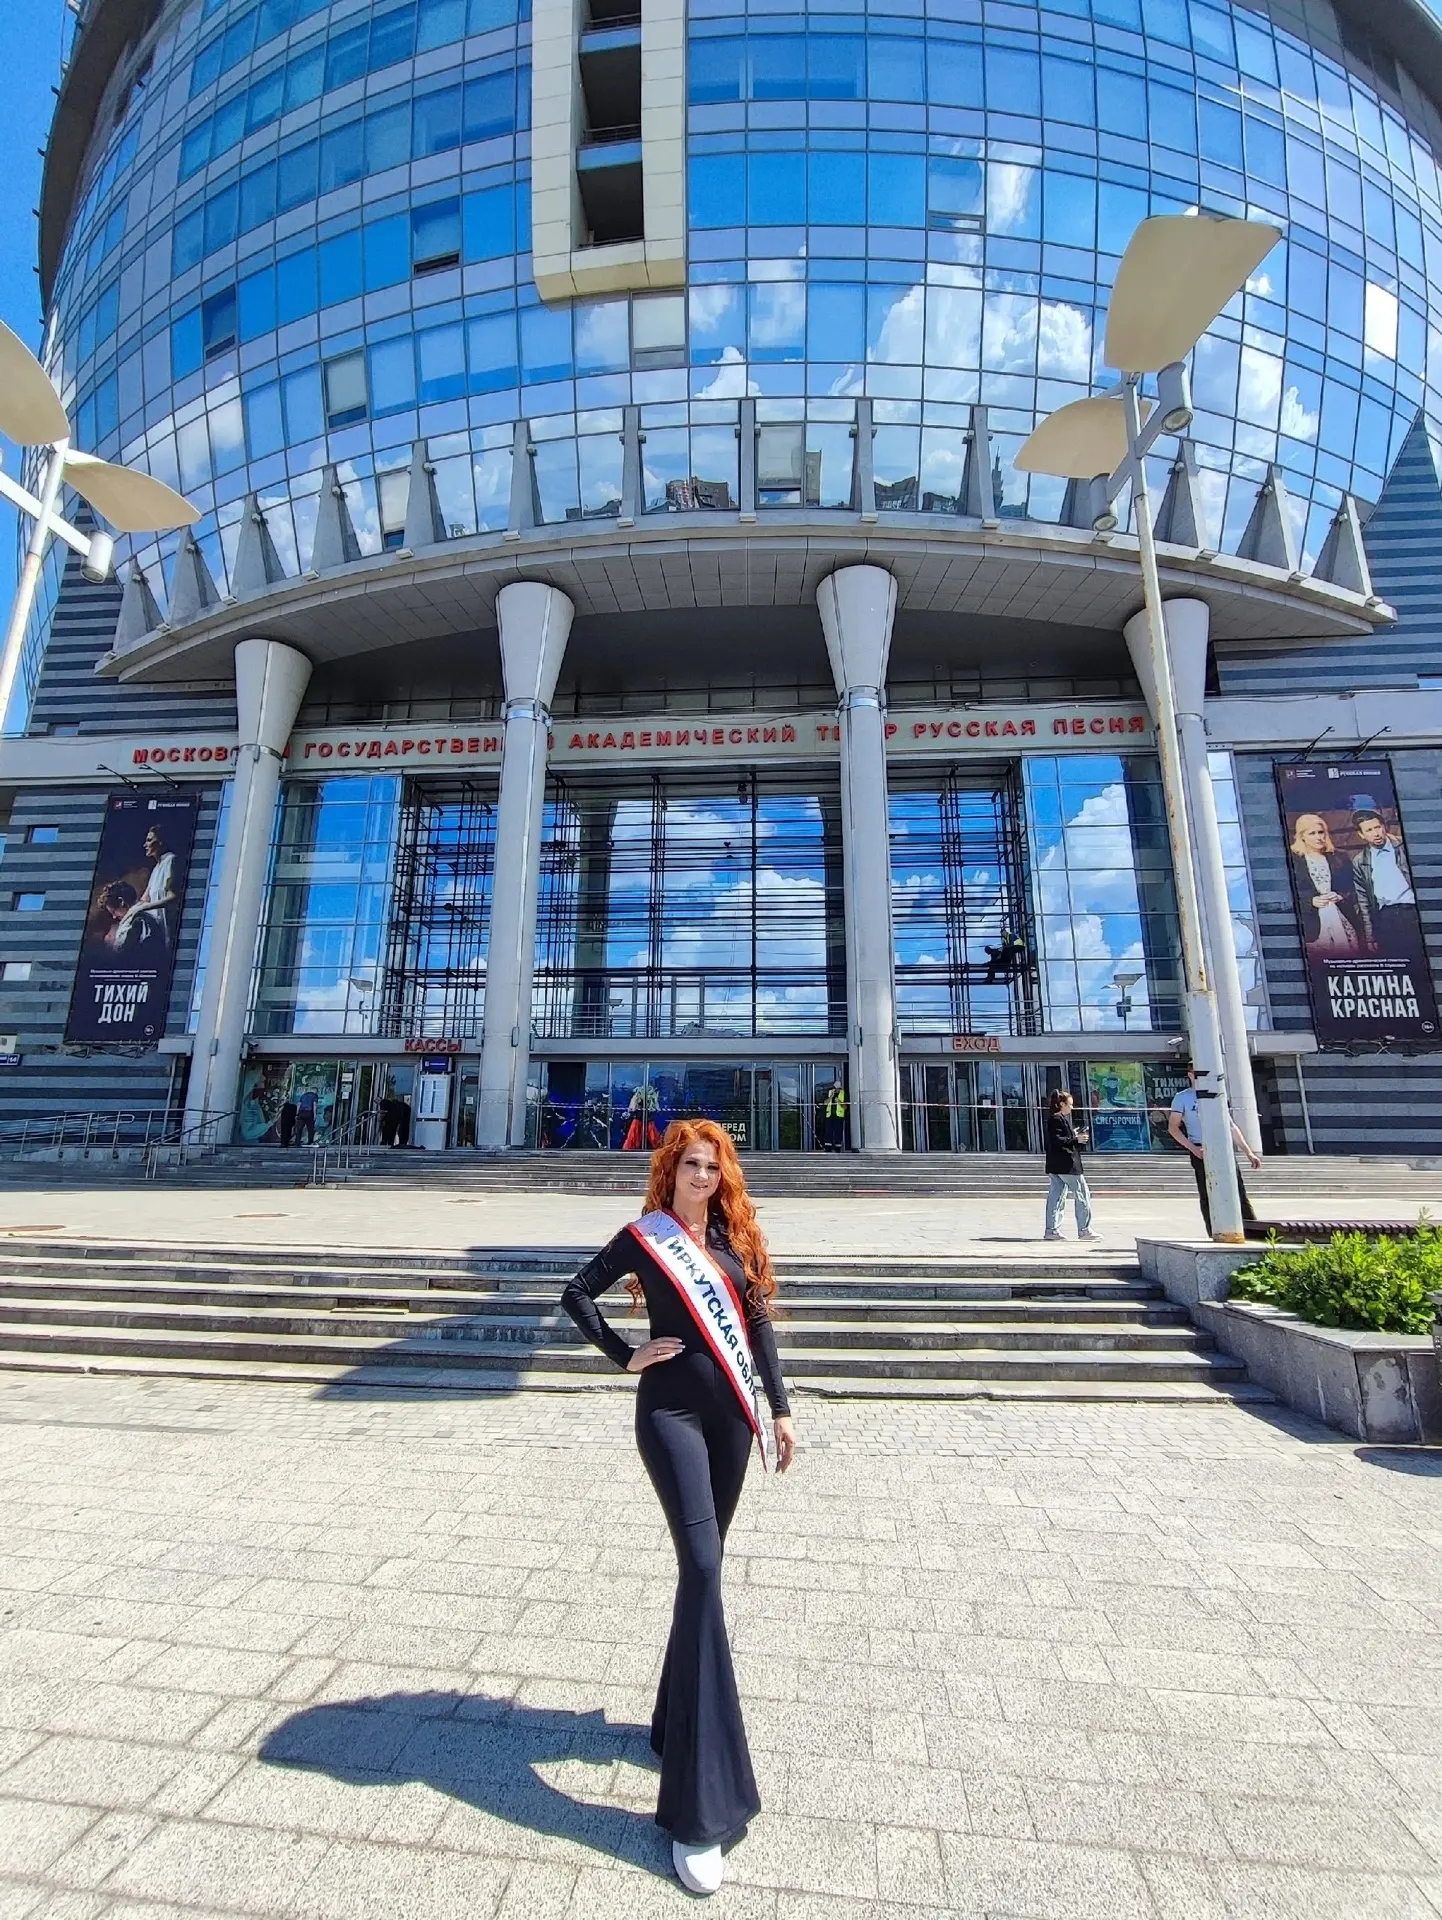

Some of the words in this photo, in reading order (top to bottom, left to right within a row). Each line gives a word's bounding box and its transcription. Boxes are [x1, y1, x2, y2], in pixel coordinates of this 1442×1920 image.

[305, 733, 554, 759] ГОСУДАРСТВЕН
[568, 725, 797, 749] АКАДЕМИЧЕСКИЙ
[913, 720, 1036, 739] РУССКАЯ
[1053, 716, 1145, 735] ПЕСНЯ
[94, 982, 149, 1003] ТИХИЙ
[1328, 975, 1415, 996] КАЛИНА
[98, 1004, 135, 1024] ДОН
[1331, 998, 1420, 1018] КРАСНАЯ
[405, 1039, 463, 1052] КАССЫ
[952, 1036, 1000, 1051] ВХОД
[721, 1123, 746, 1132] ЕРЕД
